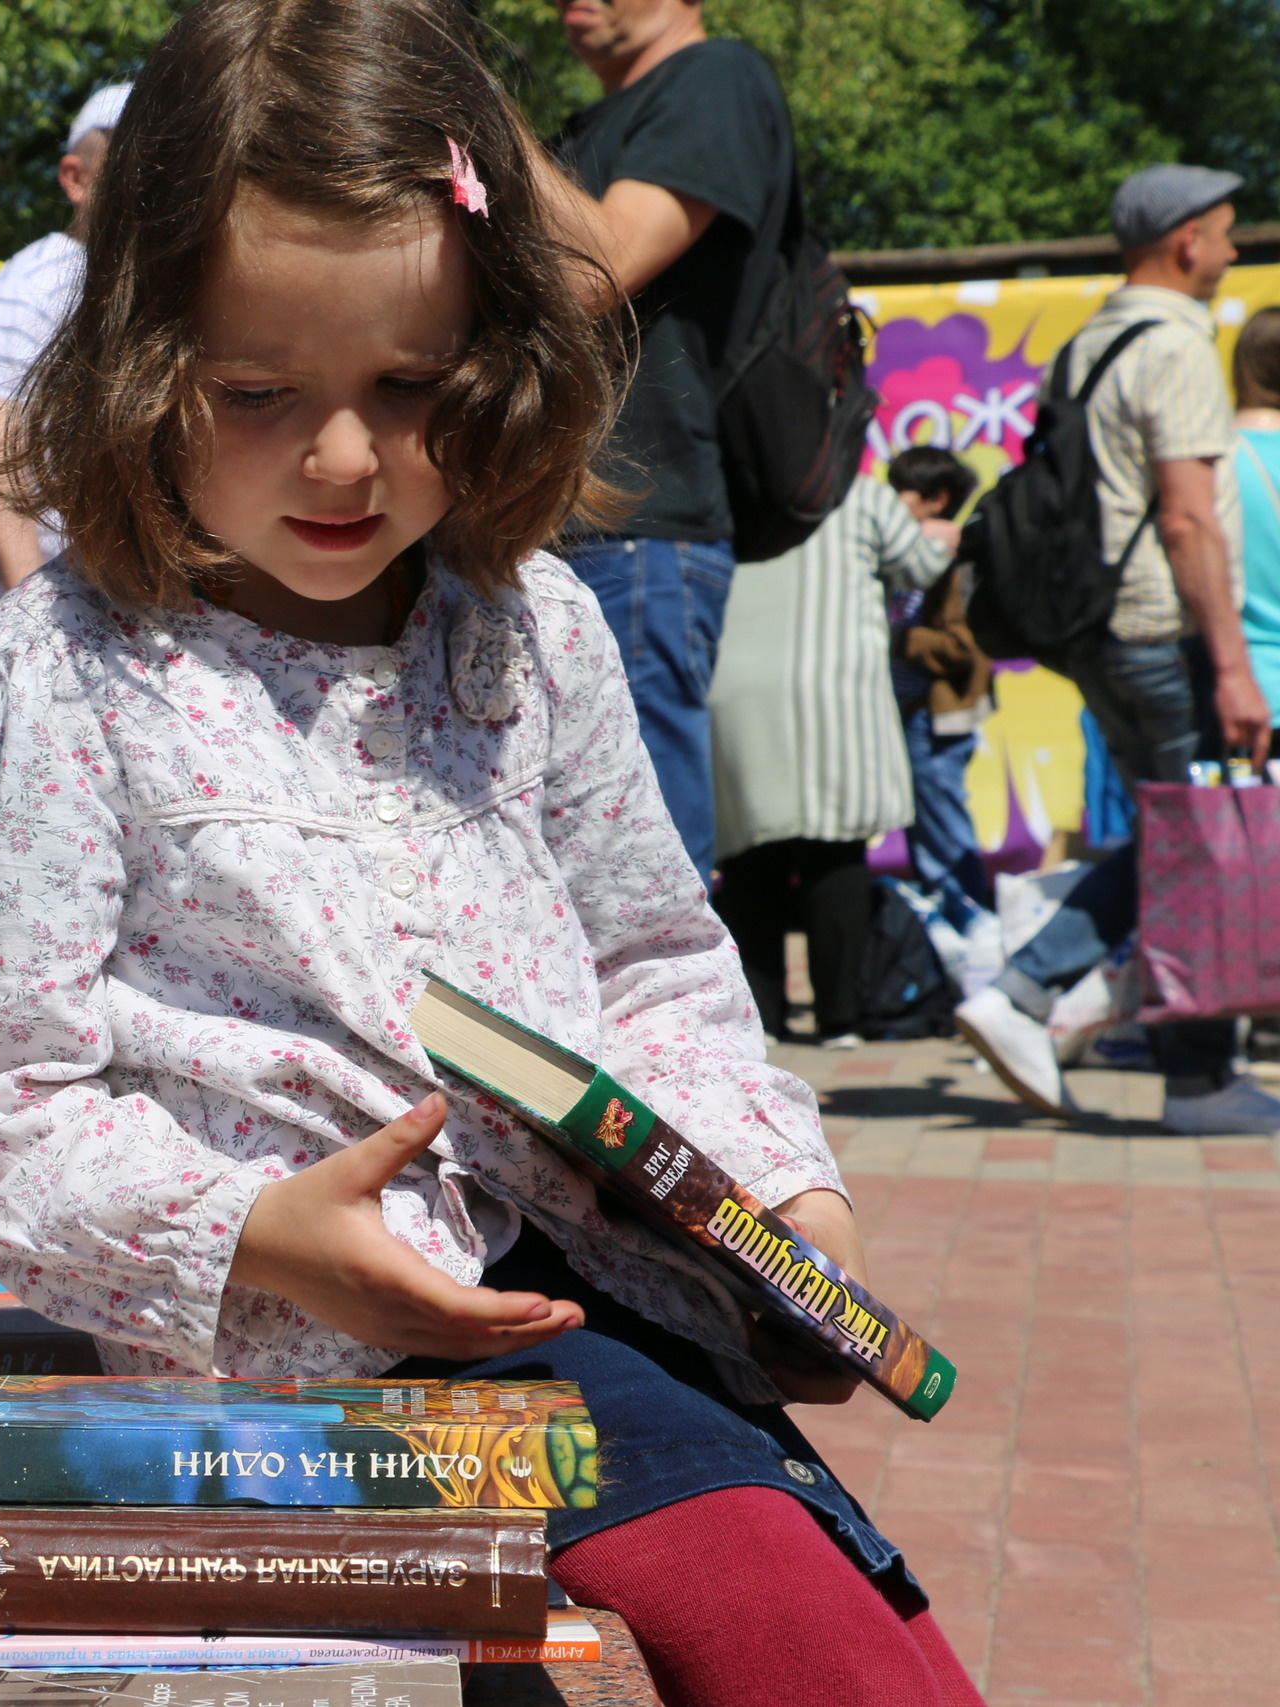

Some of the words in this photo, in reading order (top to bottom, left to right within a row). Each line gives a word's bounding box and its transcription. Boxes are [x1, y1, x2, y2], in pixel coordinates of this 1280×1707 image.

[643, 1141, 673, 1178] ВРАГ
[649, 1144, 695, 1201] НЕВЕДОМ
[706, 1197, 838, 1325] ПЕРУМОВ
[172, 1450, 285, 1477] ОДИН
[304, 1451, 356, 1478] НА
[370, 1451, 483, 1480] ОДИН
[37, 1554, 245, 1583] ФАНТАСТИКА
[258, 1558, 468, 1588] ЗАРУБЕЖНАЯ
[91, 1650, 101, 1661] и
[106, 1645, 244, 1662] очаровательная
[247, 1647, 301, 1665] Самая
[310, 1645, 404, 1660] Шереметева
[410, 1646, 463, 1660] Галина
[486, 1645, 585, 1660] АМРИТА-РУСЬ
